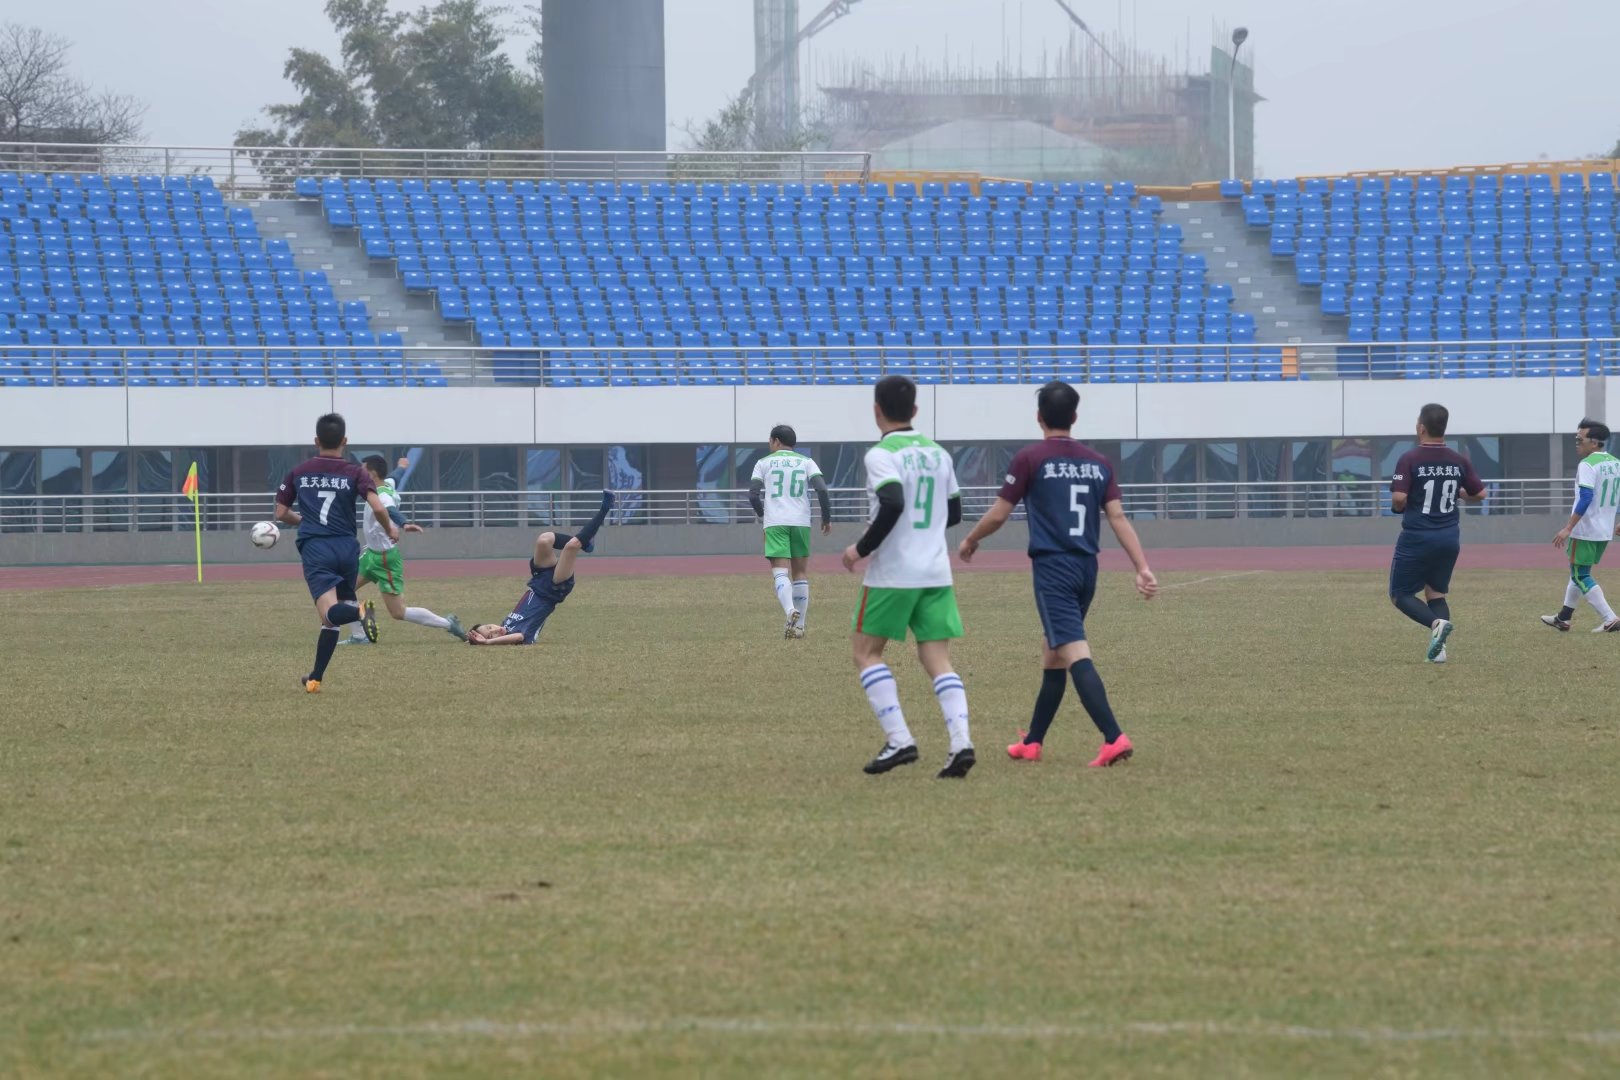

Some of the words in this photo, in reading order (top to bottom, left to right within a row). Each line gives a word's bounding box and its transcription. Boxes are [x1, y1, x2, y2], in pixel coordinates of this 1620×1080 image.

[300, 476, 351, 490] 蓝天救援队
[771, 469, 805, 499] 36
[1043, 463, 1104, 481] 蓝天救援队
[1417, 465, 1461, 477] 蓝天救援队
[317, 490, 337, 526] 7
[913, 476, 935, 529] 9
[1069, 484, 1089, 537] 5
[1421, 480, 1458, 514] 18
